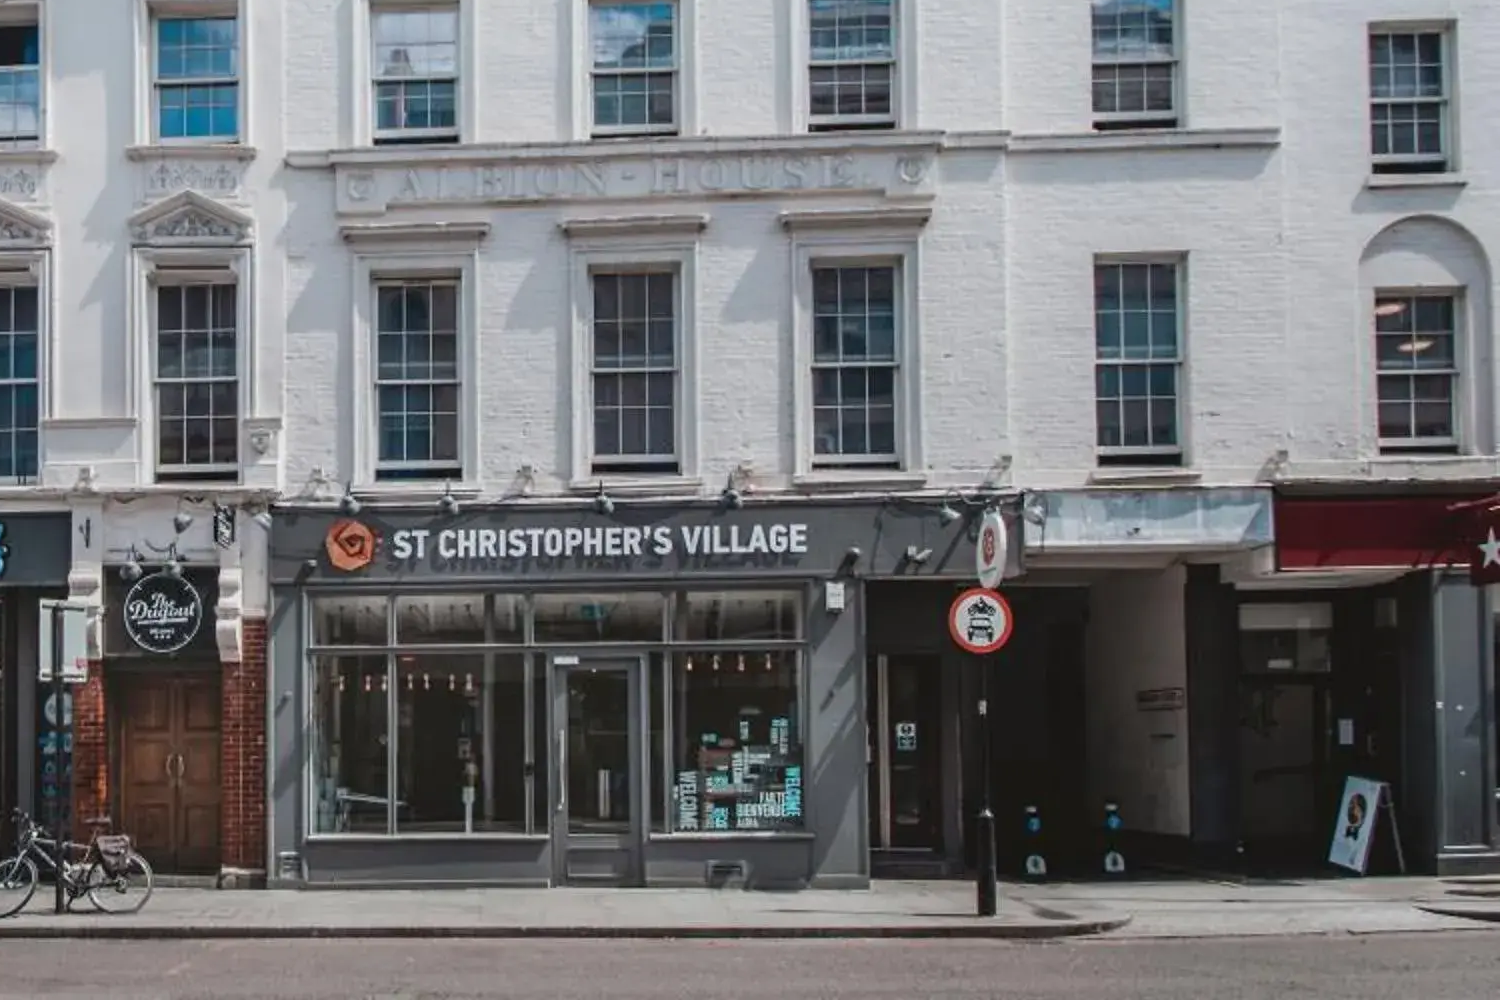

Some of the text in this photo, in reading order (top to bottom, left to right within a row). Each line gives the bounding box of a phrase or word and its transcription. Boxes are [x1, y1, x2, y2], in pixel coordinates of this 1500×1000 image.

[392, 159, 610, 201] ALBION
[393, 524, 808, 559] ST CHRISTOPHER'S VILLAGE
[151, 592, 177, 609] The
[680, 771, 699, 829] WELCOME
